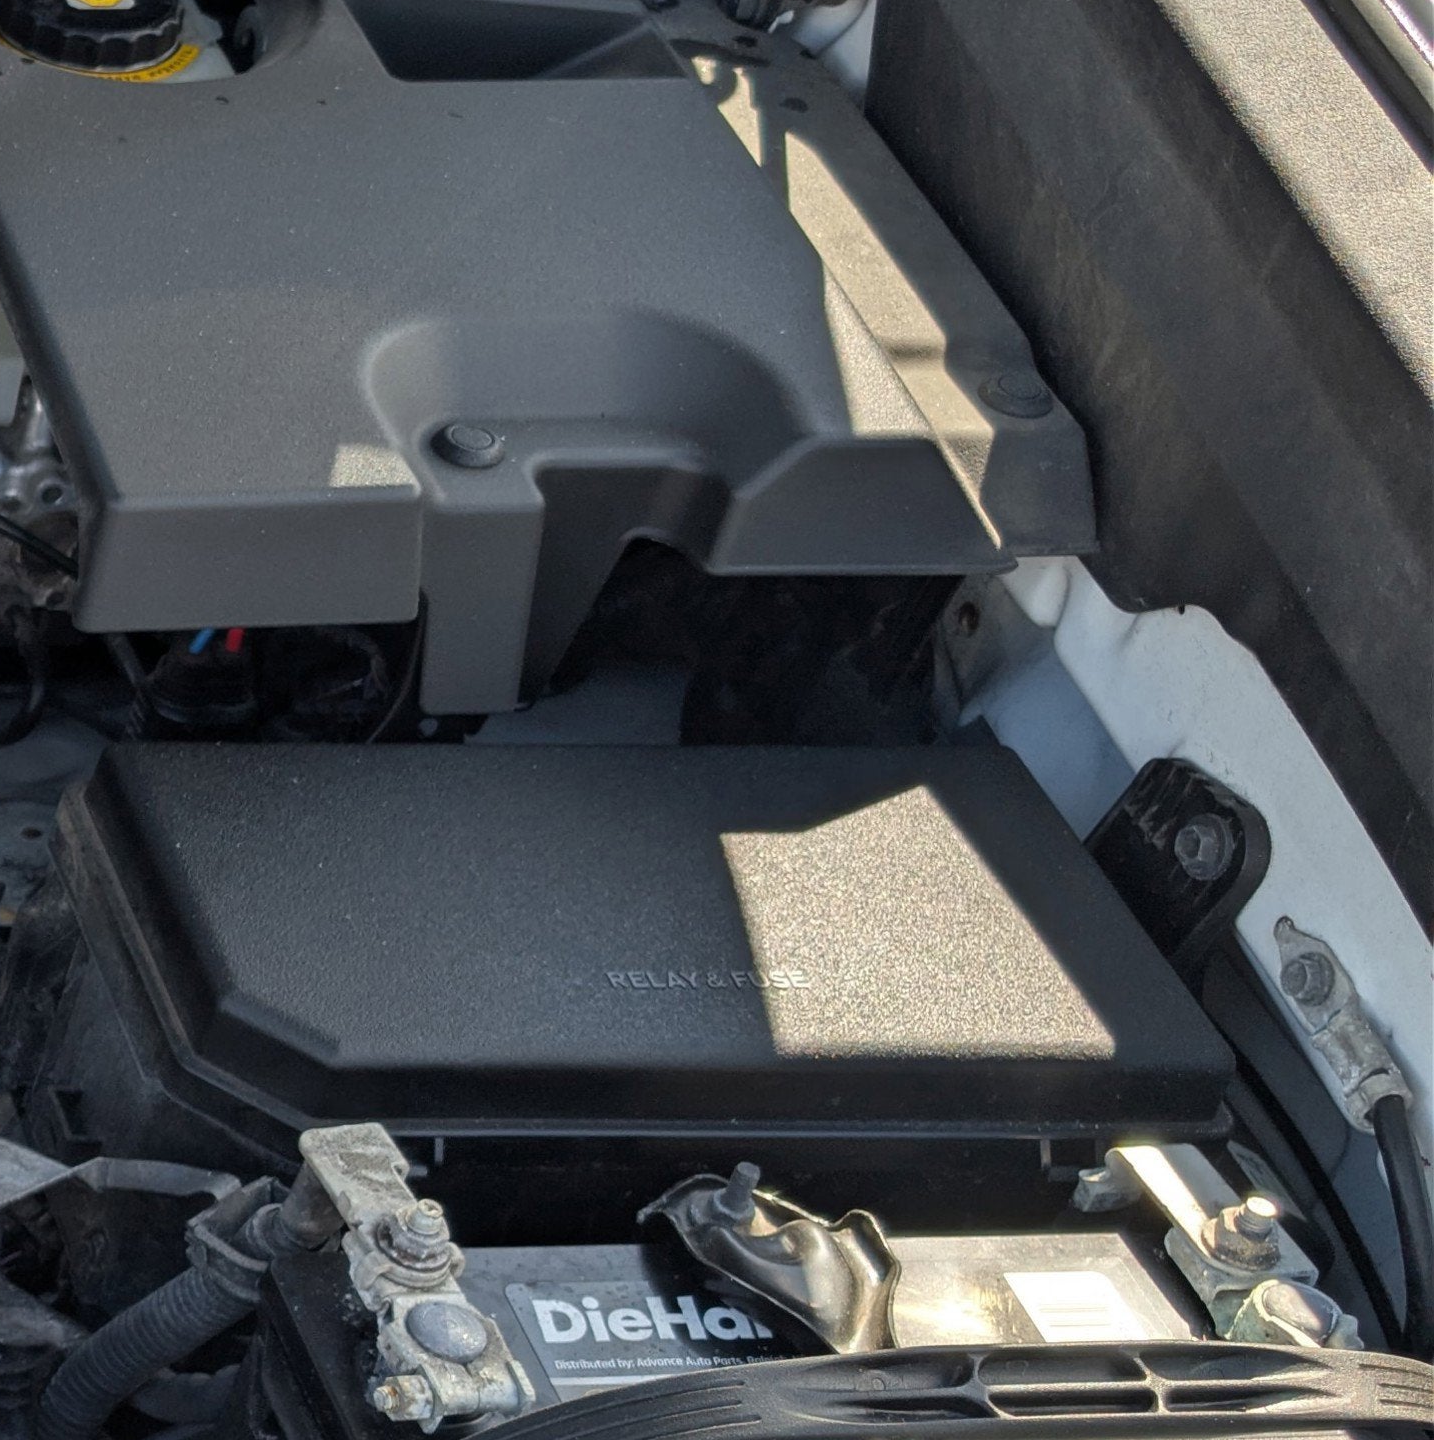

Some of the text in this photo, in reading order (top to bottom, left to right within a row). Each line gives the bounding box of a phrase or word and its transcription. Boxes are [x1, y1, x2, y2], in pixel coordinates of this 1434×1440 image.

[605, 969, 810, 991] RELAY & FUSE
[554, 1358, 615, 1371] Distributed
[637, 1356, 683, 1368] Advance
[686, 1355, 712, 1367] Auto
